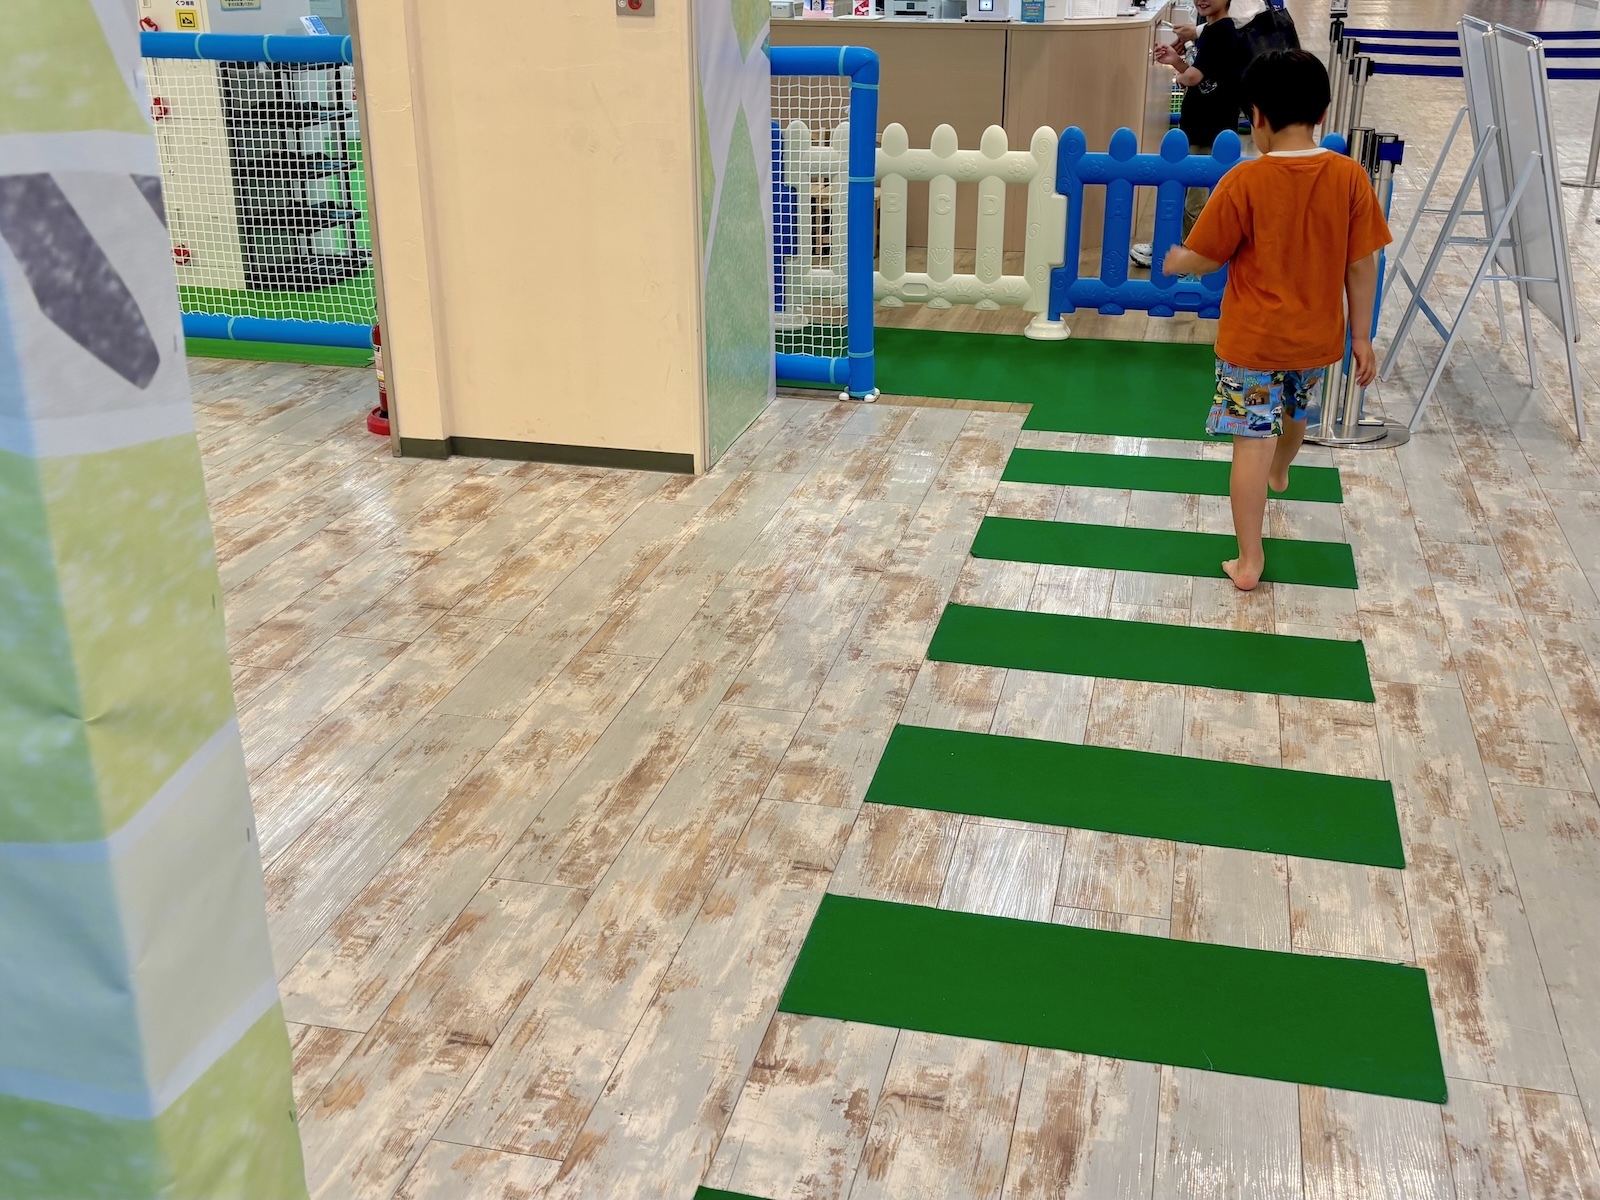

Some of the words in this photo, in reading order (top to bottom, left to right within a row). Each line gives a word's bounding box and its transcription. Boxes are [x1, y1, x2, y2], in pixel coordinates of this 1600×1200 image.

[883, 192, 902, 213] B
[932, 193, 951, 215] C
[982, 194, 1000, 215] D
